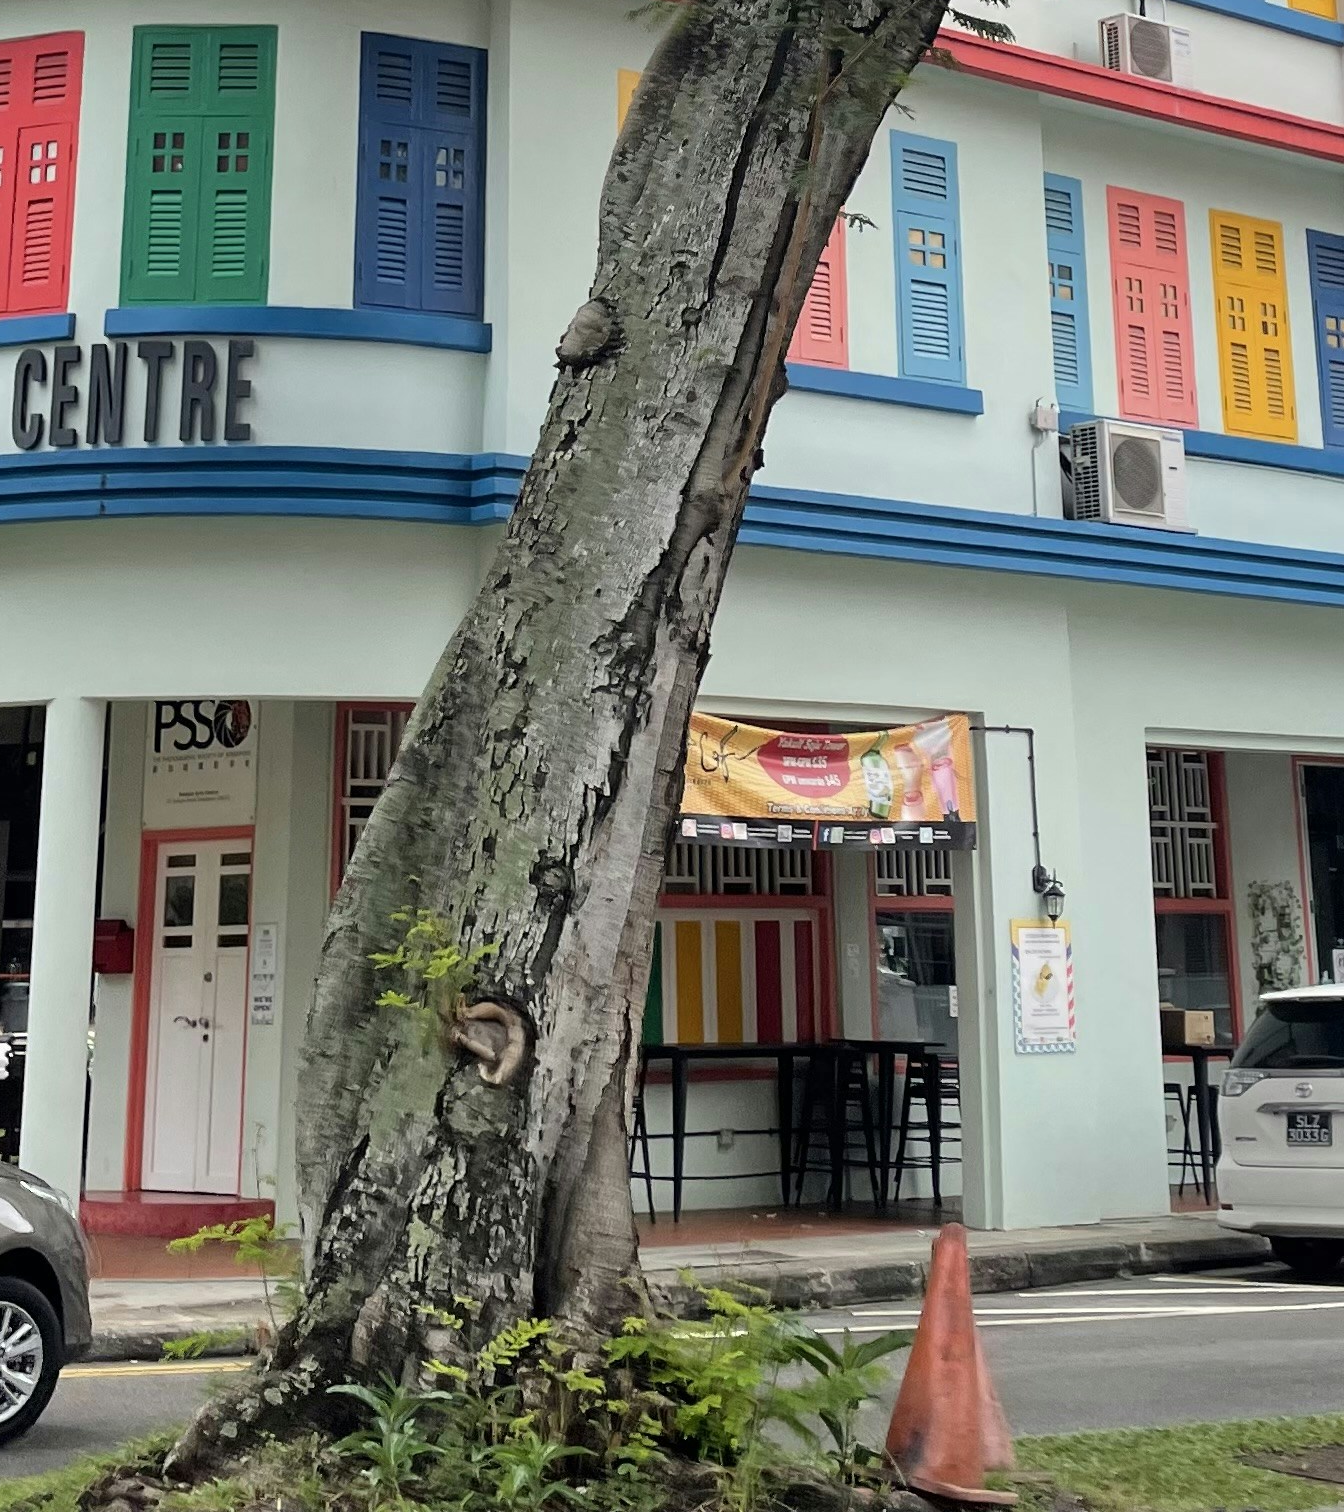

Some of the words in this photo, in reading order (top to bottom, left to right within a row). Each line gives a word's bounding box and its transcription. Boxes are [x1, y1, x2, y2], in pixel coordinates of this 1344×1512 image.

[11, 339, 254, 451] CENTRE
[1296, 1115, 1321, 1129] SLZ
[1288, 1129, 1331, 1142] 3033G
